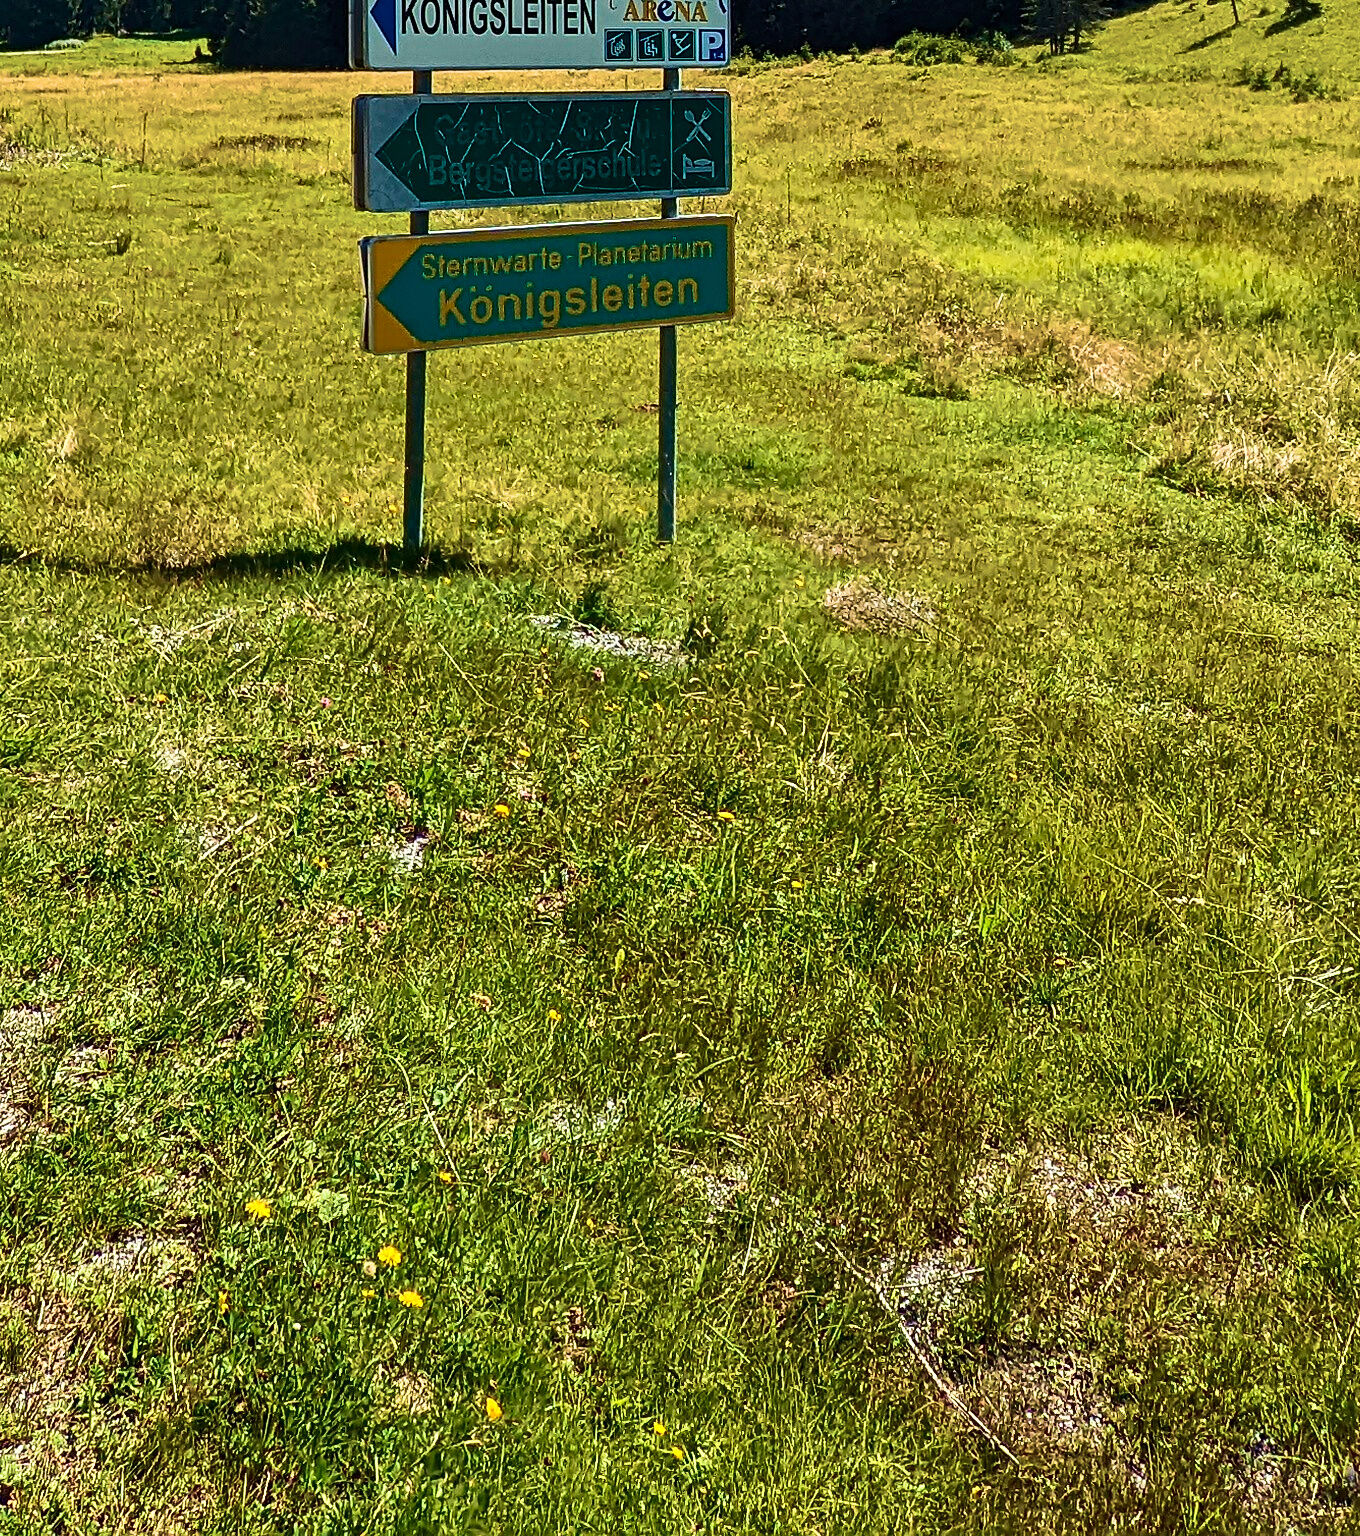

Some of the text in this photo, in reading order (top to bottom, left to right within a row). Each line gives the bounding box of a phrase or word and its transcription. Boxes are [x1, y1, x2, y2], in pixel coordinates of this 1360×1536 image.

[421, 246, 562, 281] Sternwarte
[577, 235, 713, 267] Planetarium
[439, 273, 700, 329] Königsleiten
